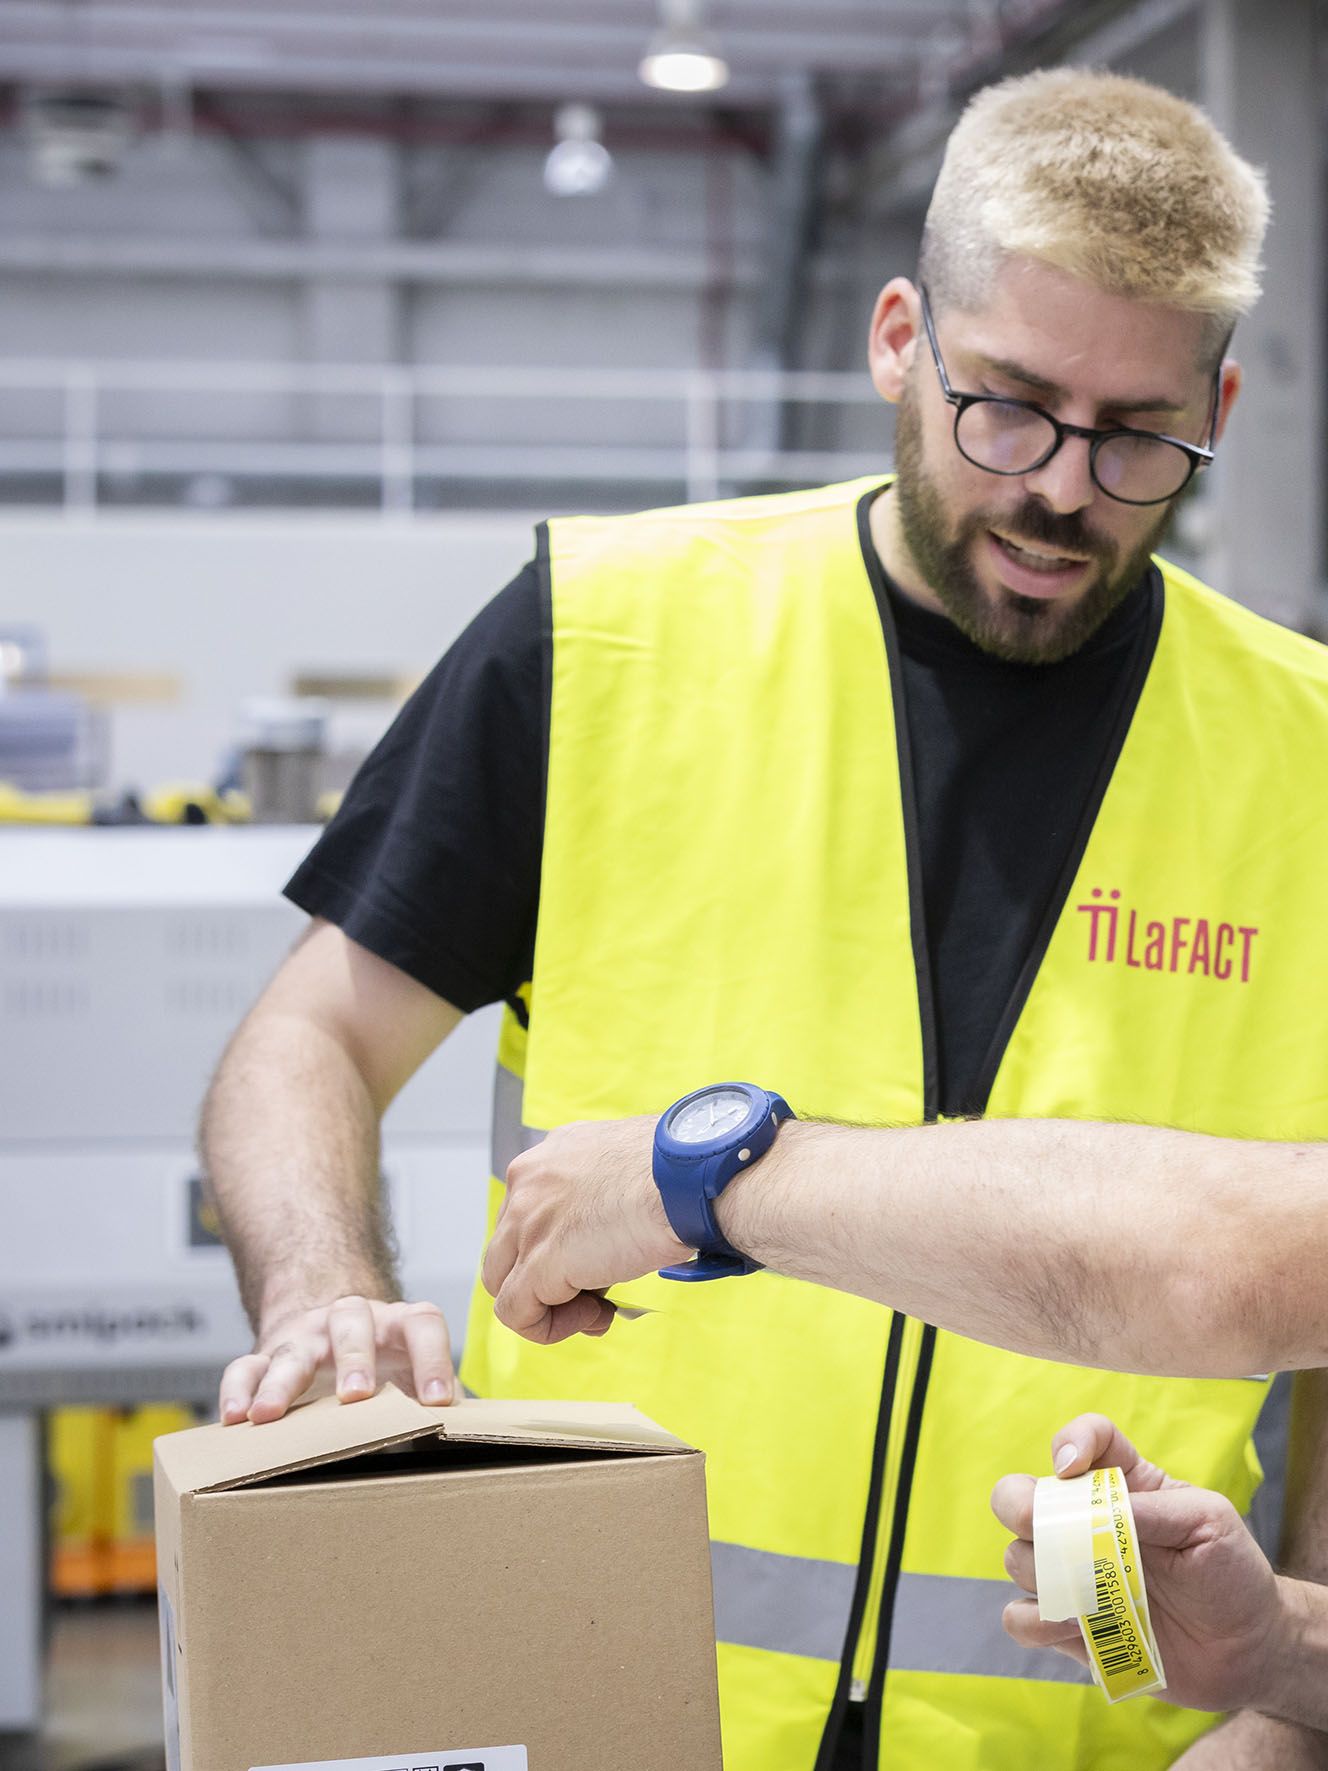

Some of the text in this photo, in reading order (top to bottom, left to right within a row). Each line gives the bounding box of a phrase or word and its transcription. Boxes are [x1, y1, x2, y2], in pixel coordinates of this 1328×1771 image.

[1126, 909, 1259, 983] LaFACT
[1102, 1561, 1149, 1676] 8 429603 001580
